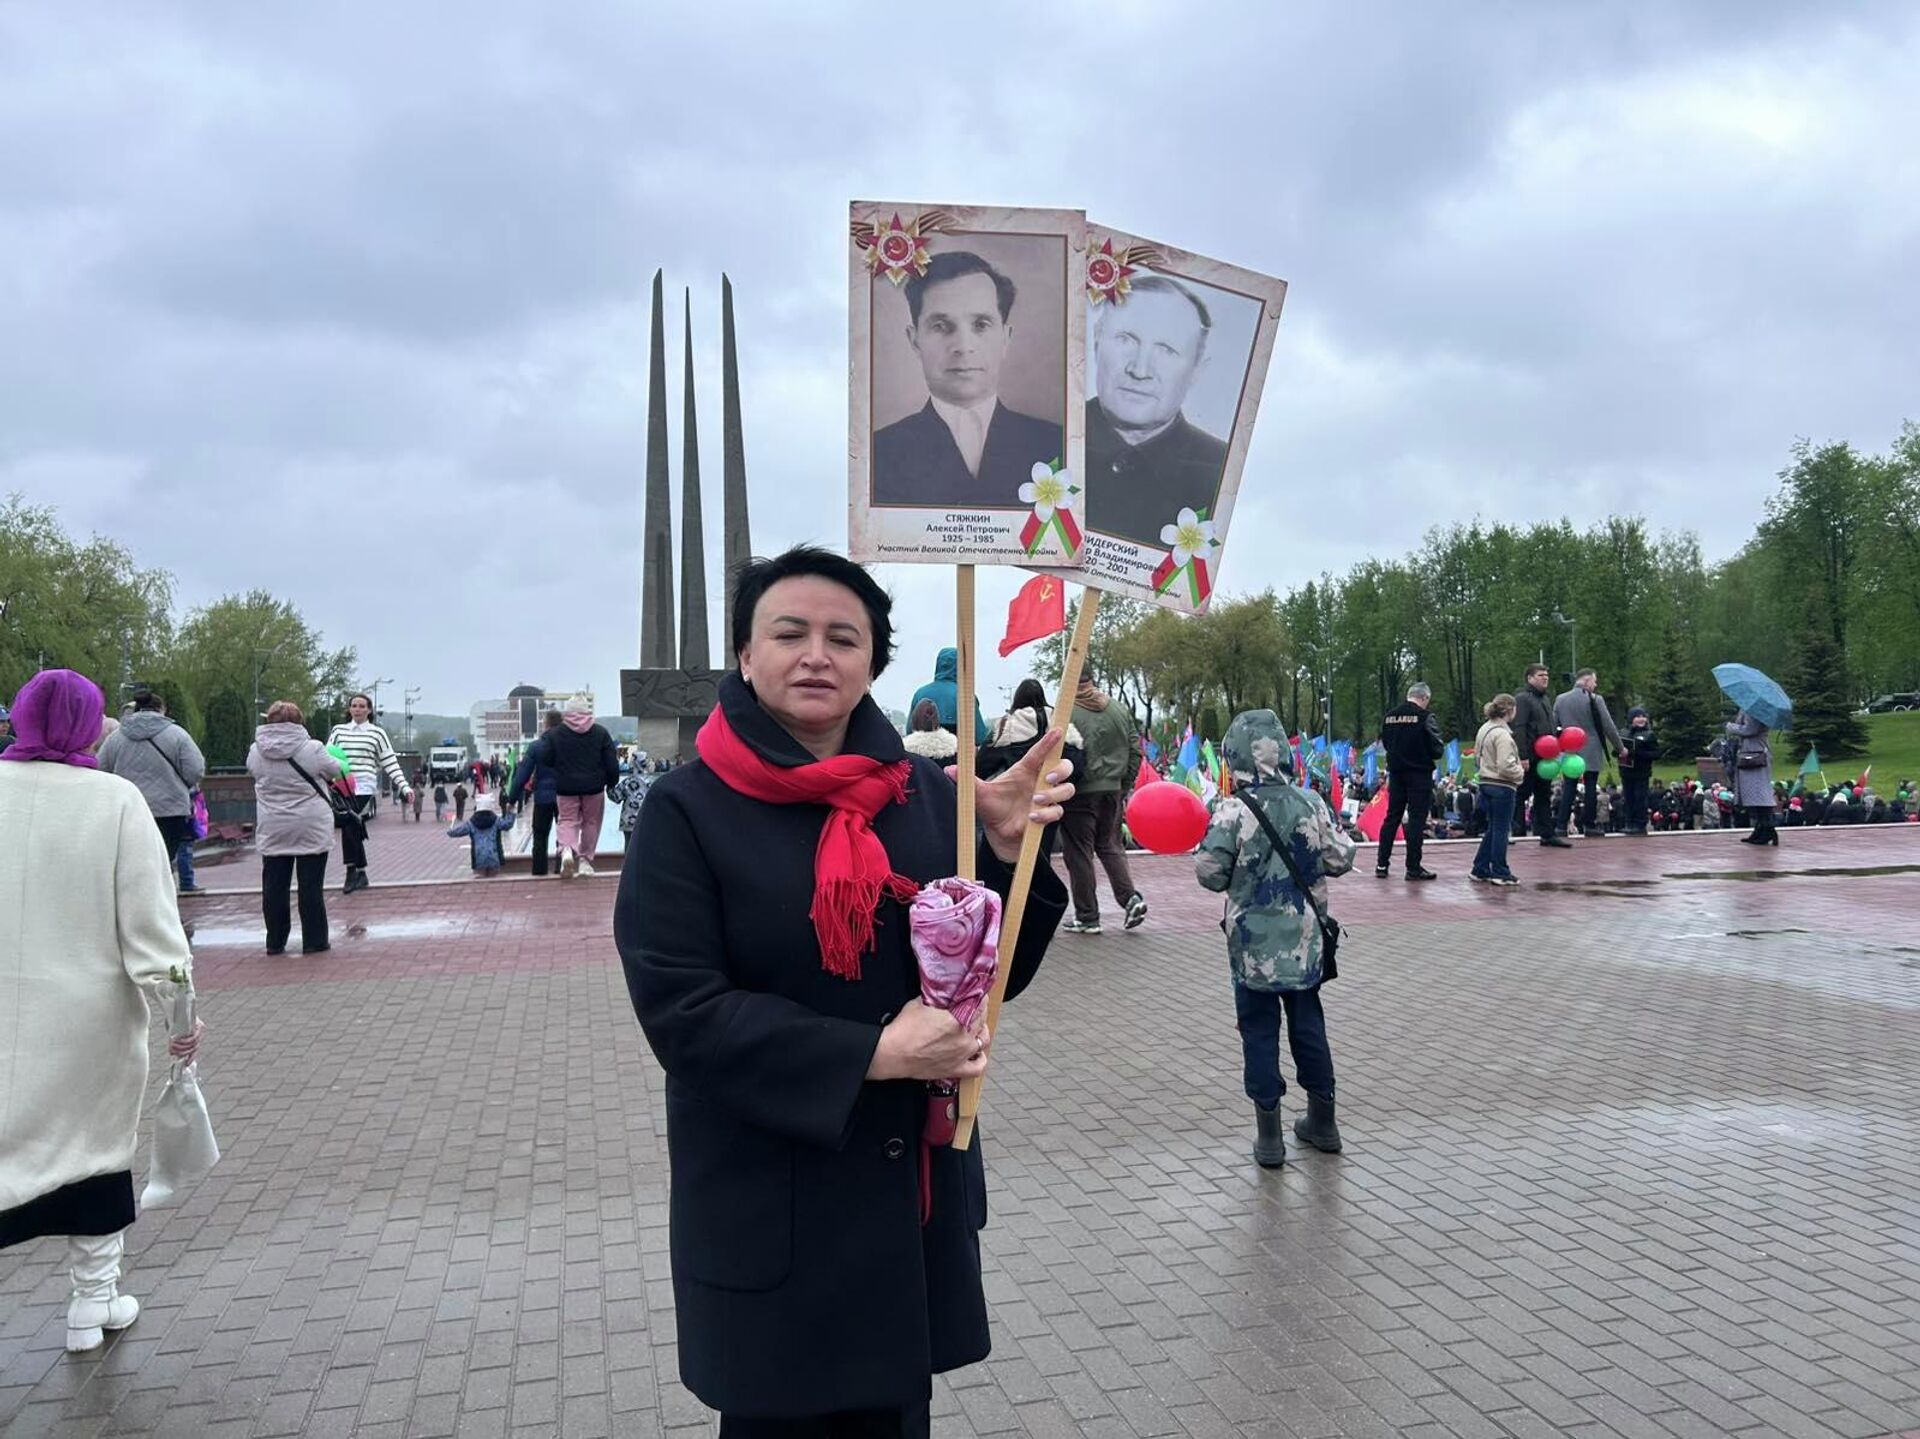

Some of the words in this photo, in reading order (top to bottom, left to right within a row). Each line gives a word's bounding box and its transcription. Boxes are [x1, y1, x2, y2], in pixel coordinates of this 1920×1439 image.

[945, 514, 991, 523] СТЯЖКИН
[926, 524, 964, 533] Алексей
[966, 525, 1010, 535] Петрович
[942, 534, 963, 543] 1925
[973, 535, 995, 544] 1985
[877, 544, 919, 553] Участник
[921, 545, 957, 554] Великой
[1107, 561, 1128, 575] 2001
